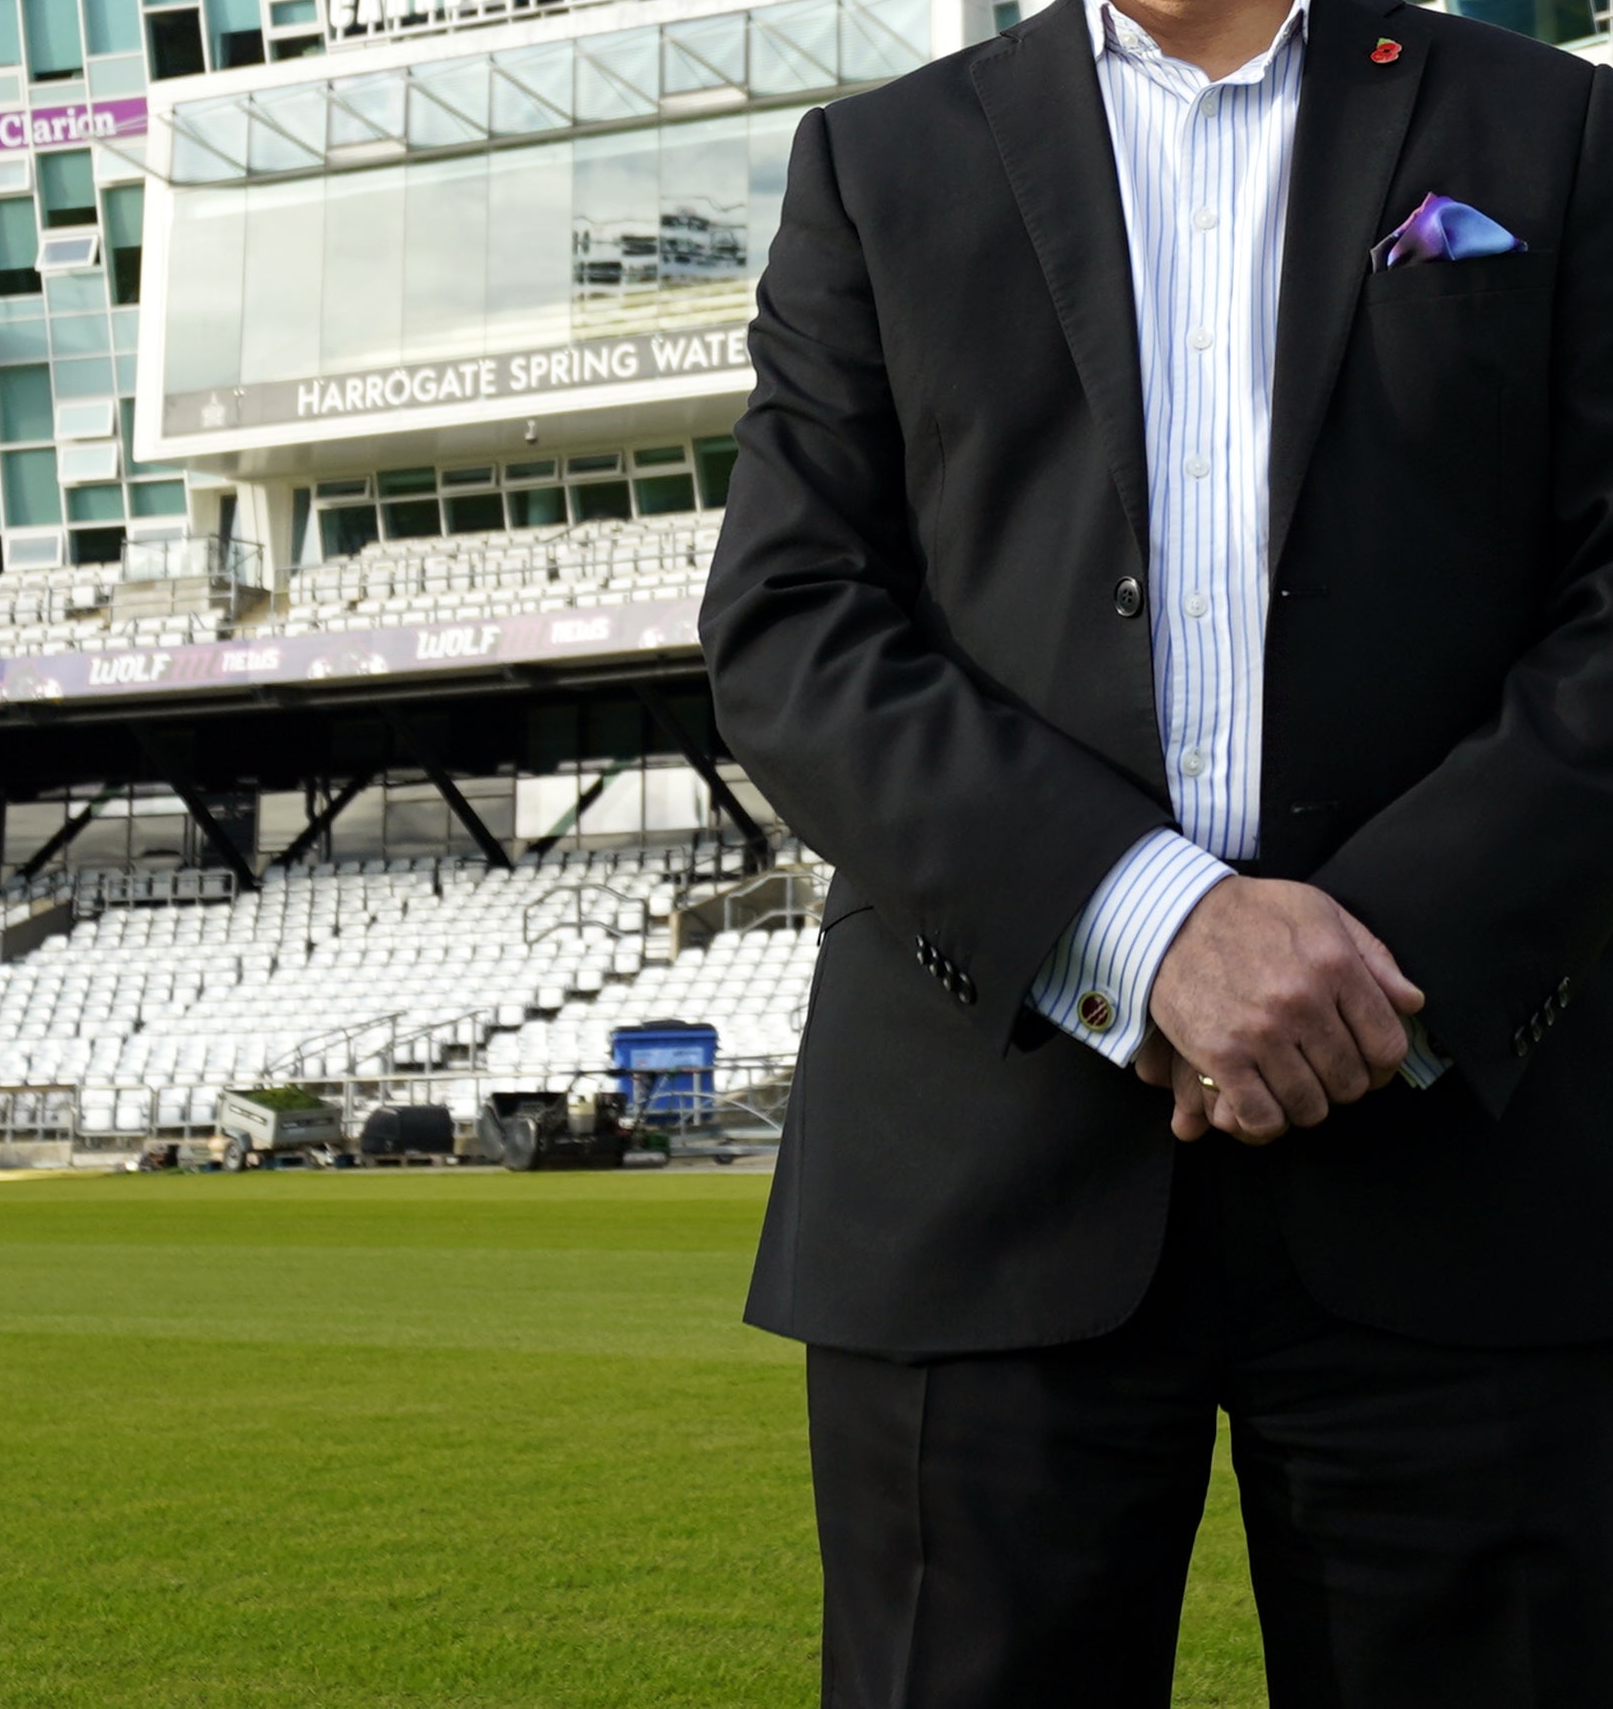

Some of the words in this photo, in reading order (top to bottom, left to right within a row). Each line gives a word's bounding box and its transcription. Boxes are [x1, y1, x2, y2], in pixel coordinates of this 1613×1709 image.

[297, 362, 496, 417] HARROGATE
[510, 344, 637, 390] SPRING
[653, 328, 750, 372] WATE
